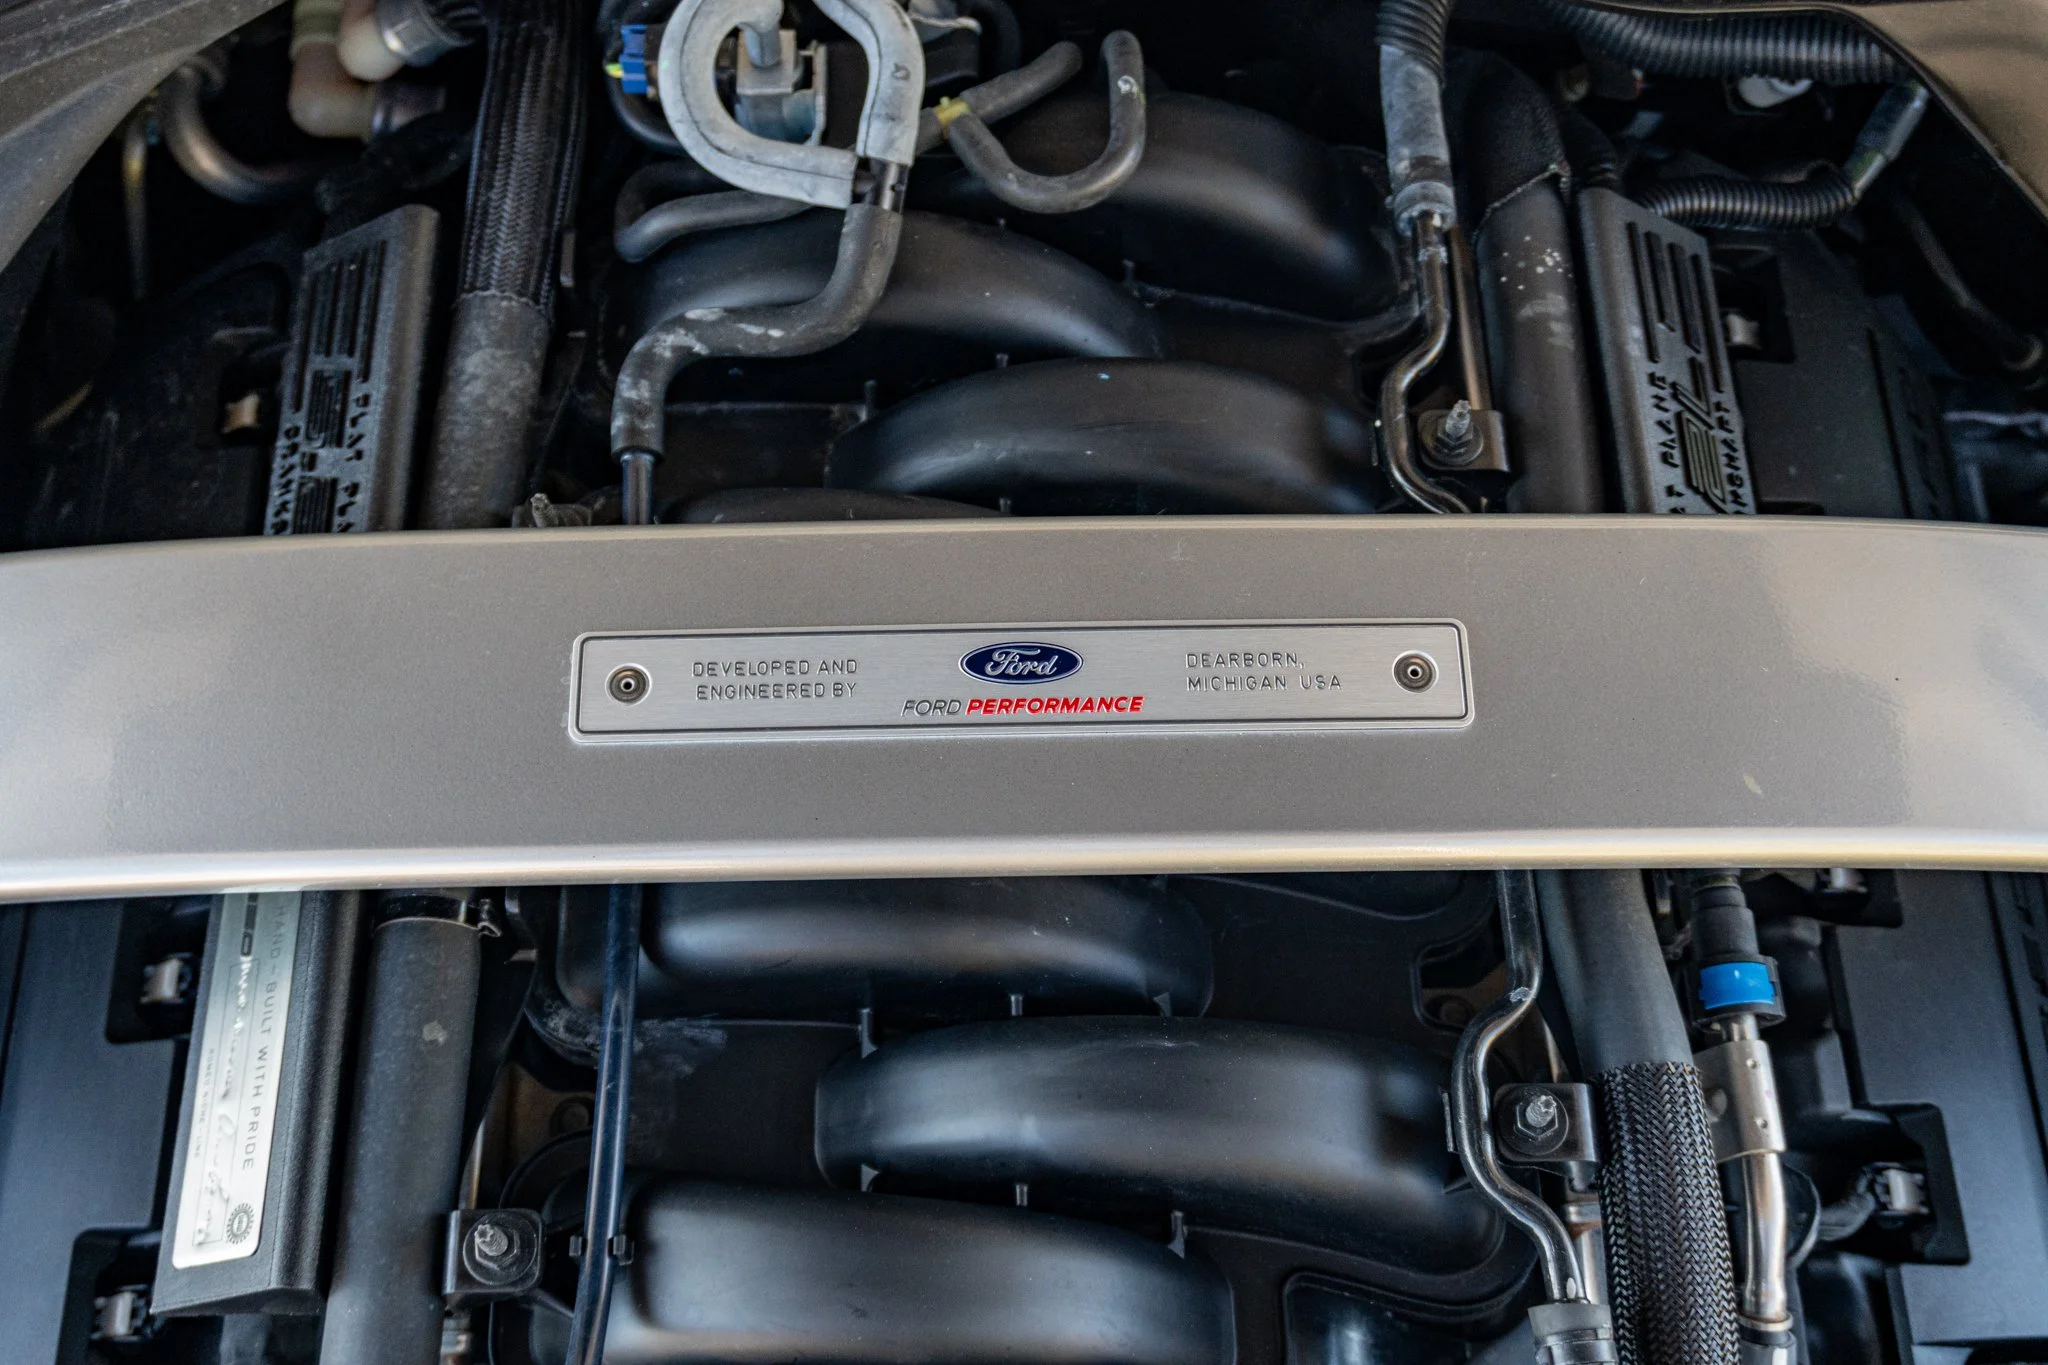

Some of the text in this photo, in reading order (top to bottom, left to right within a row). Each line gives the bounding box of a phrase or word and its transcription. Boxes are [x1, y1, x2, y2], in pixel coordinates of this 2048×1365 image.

[1646, 371, 1680, 468] PLANE
[692, 659, 858, 677] DEVELOPED AND
[984, 648, 1058, 676] Ford
[1185, 652, 1305, 669] DEARBORN,
[696, 682, 857, 700] ENGINEERED BY
[1186, 674, 1342, 691] MICHIGAN USA
[900, 696, 1145, 717] FORD PERFORMANCE
[250, 1048, 269, 1098] WITH
[242, 1106, 262, 1171] PRIDE
